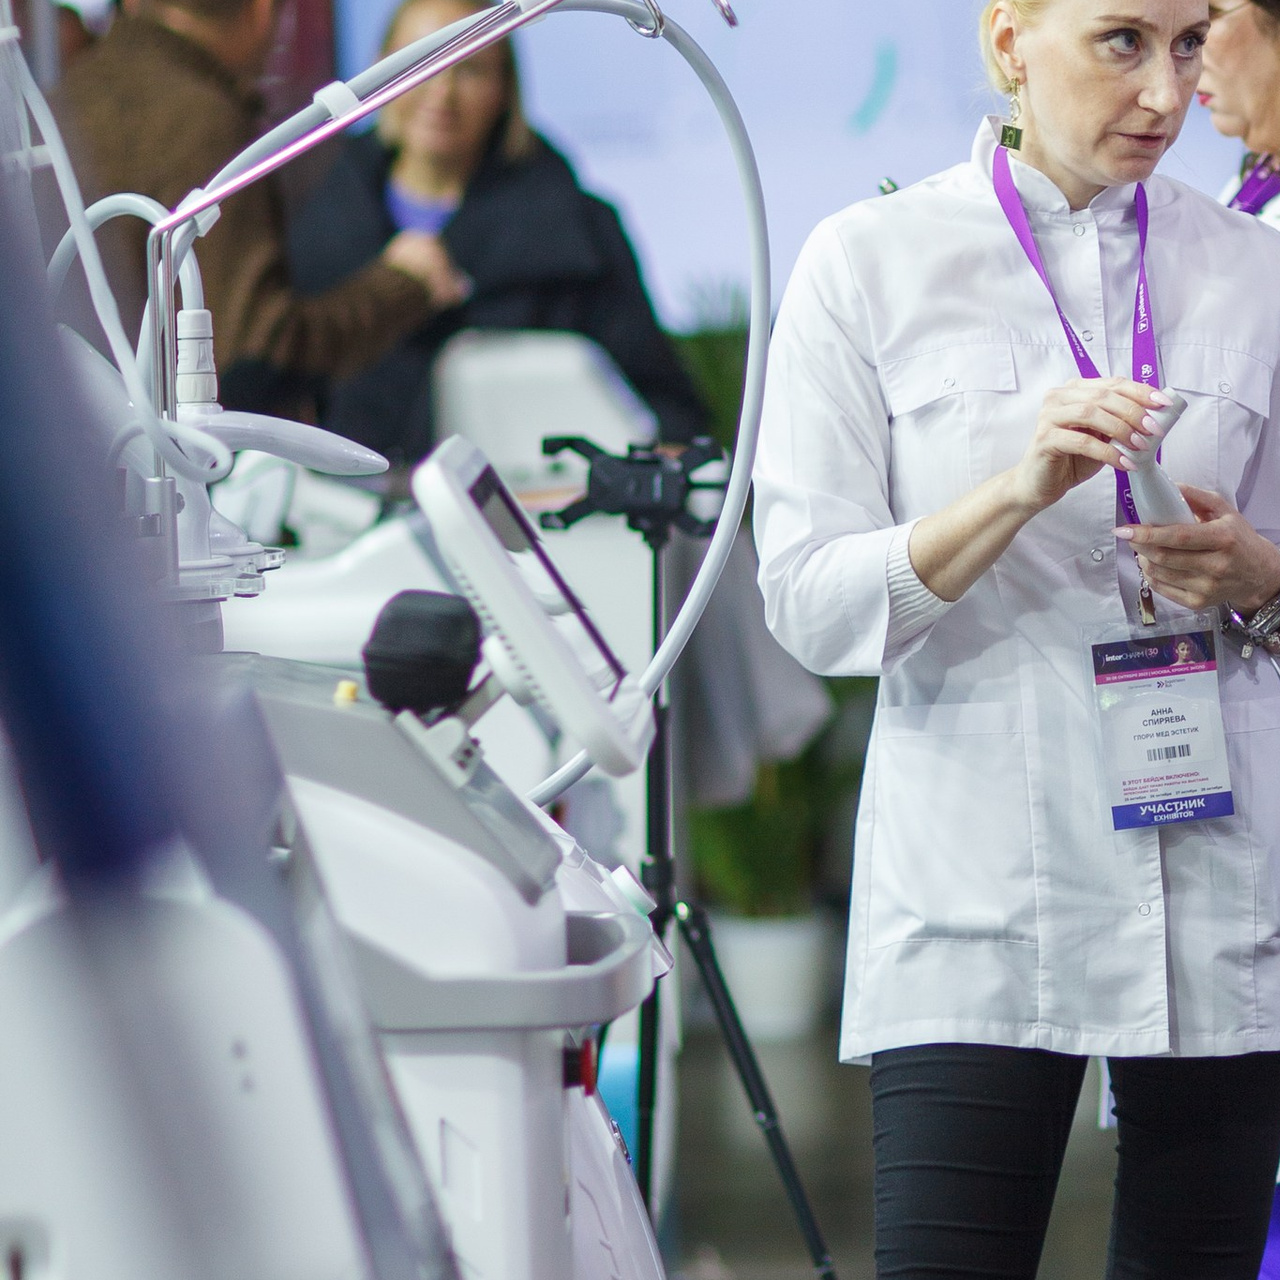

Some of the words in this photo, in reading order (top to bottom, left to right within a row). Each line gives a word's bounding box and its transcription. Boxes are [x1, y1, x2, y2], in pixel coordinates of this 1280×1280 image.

[1151, 707, 1173, 716] АННА
[1142, 715, 1186, 726] СПИРЯЕВА
[1171, 726, 1199, 736] ЭСТЕТИК
[1140, 798, 1205, 815] УЧАСТНИК
[1154, 810, 1194, 822] EXHIBITOR
